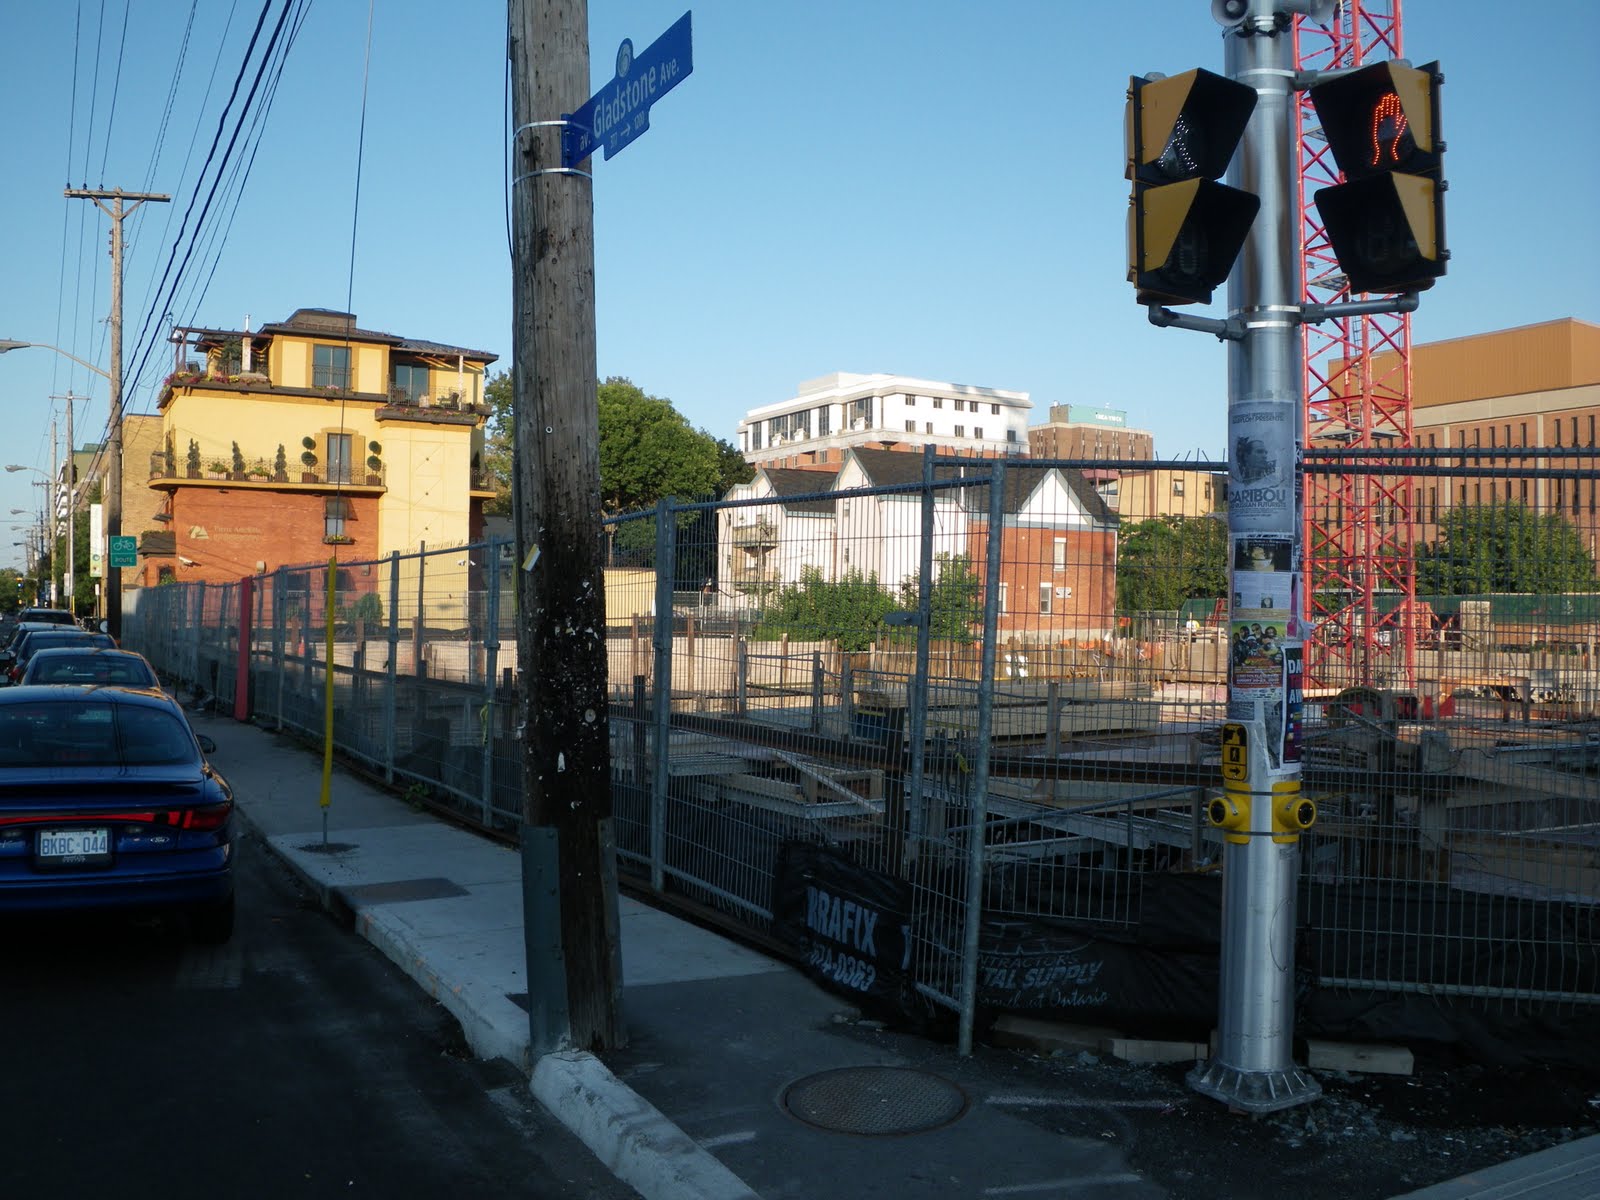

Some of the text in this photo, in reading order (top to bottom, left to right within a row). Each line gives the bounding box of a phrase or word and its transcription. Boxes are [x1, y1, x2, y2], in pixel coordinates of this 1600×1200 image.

[579, 58, 680, 151] av. Gladstone Ave.
[83, 836, 106, 853] 044
[1022, 960, 1104, 989] SUPPLY
